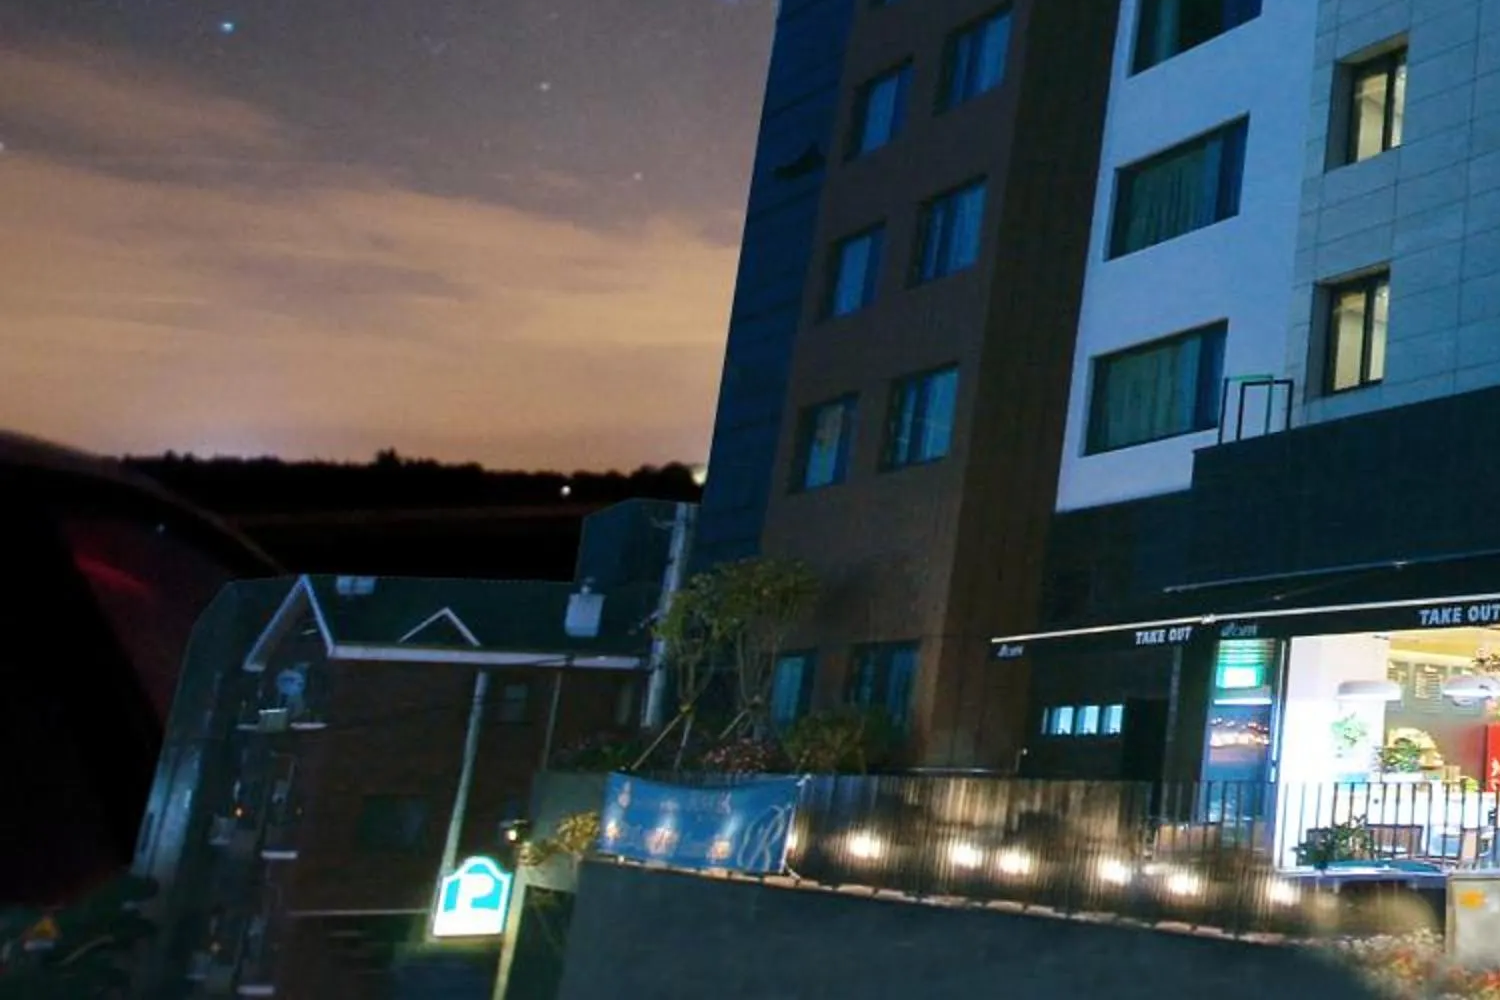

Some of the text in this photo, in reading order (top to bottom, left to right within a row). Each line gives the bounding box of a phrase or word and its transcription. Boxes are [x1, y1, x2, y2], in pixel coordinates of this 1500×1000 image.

[1418, 606, 1462, 626] TAKE
[1135, 625, 1193, 646] TAKE OUT
